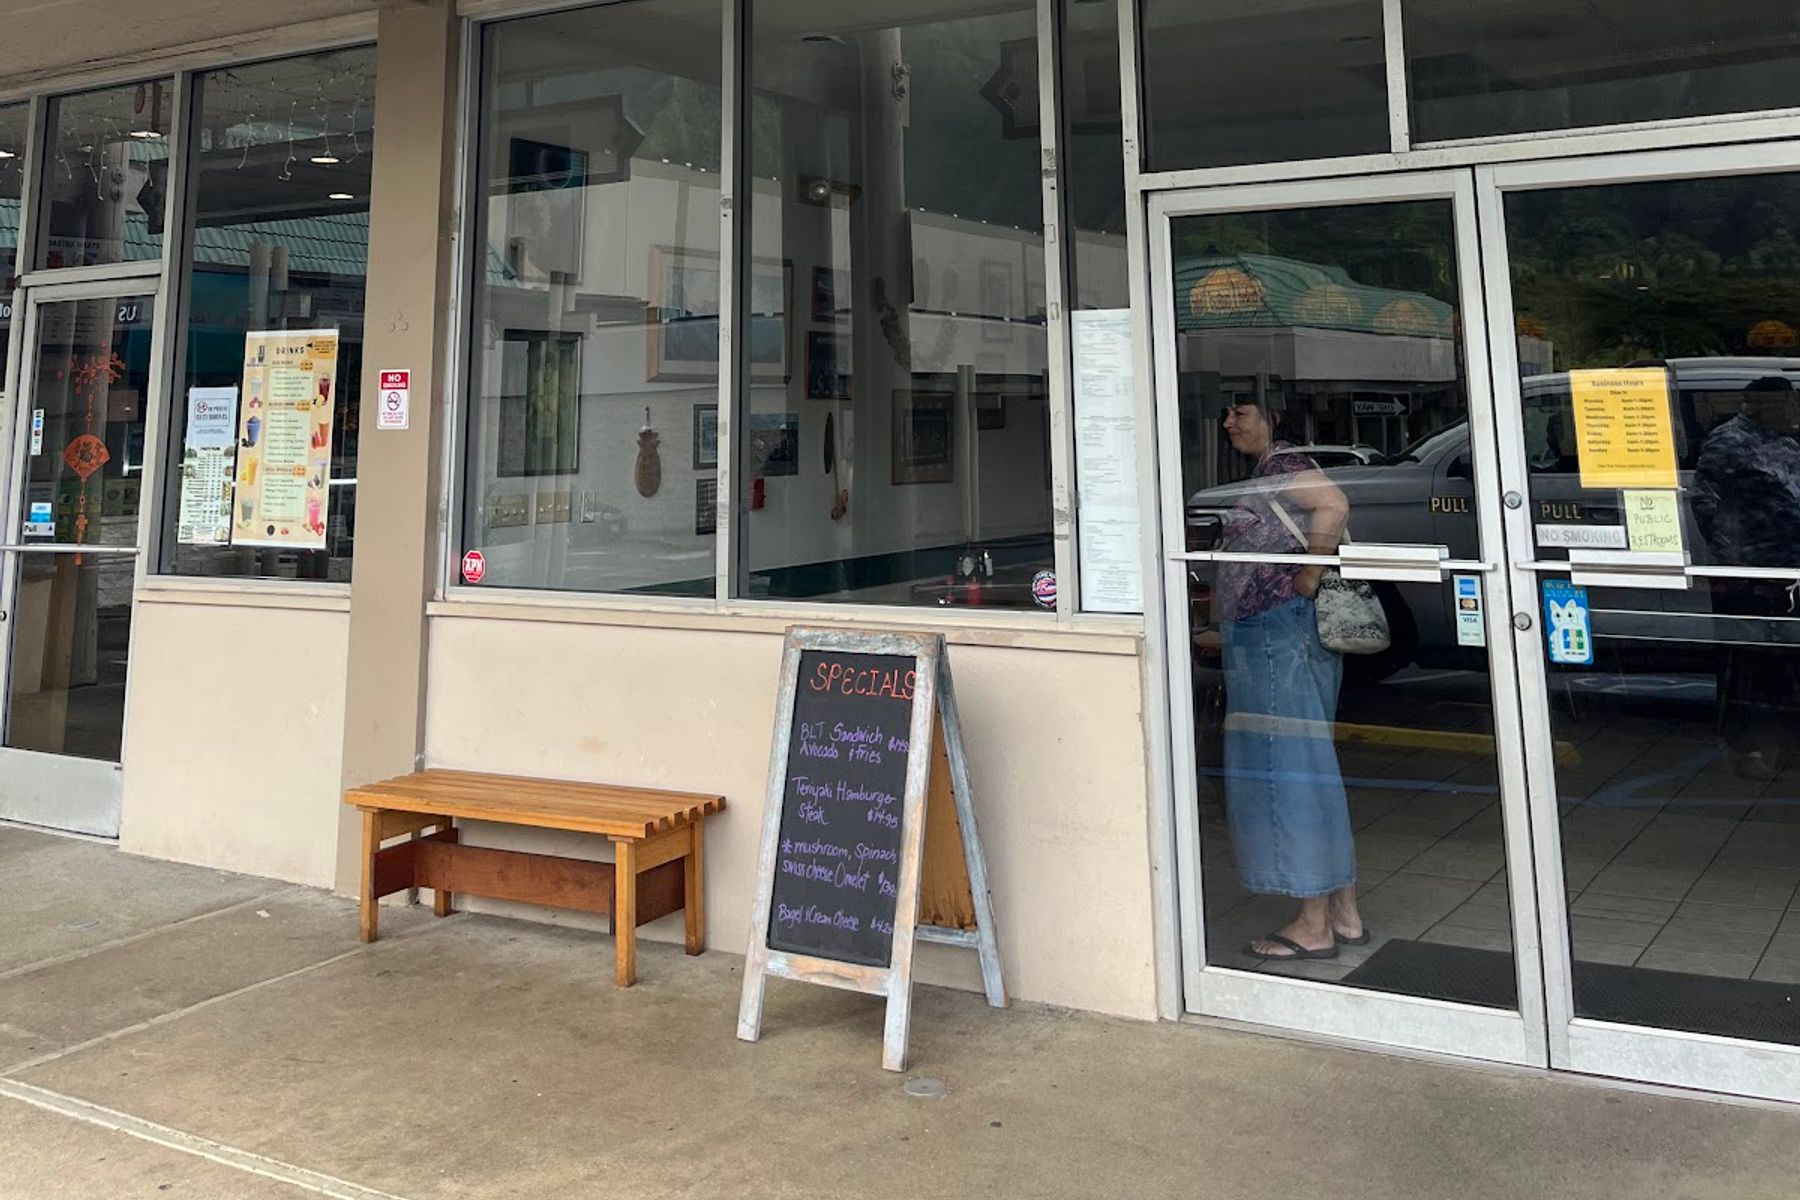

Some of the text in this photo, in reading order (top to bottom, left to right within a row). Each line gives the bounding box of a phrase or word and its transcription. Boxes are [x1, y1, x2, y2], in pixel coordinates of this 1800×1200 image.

[276, 346, 305, 354] DRINKS
[387, 373, 402, 382] NO
[1431, 497, 1469, 513] PULL
[1542, 503, 1582, 520] PULL
[1633, 513, 1673, 524] PUBLIC
[1541, 529, 1622, 545] NO SMOKING
[1631, 534, 1679, 548] RESTROOMS
[810, 662, 917, 700] SPECIALS
[800, 721, 825, 741] BLT
[829, 722, 883, 745] Sandwich
[799, 740, 838, 759] Avocado
[792, 776, 897, 810] Teriyaki Hamburger
[779, 903, 803, 929] Bagel
